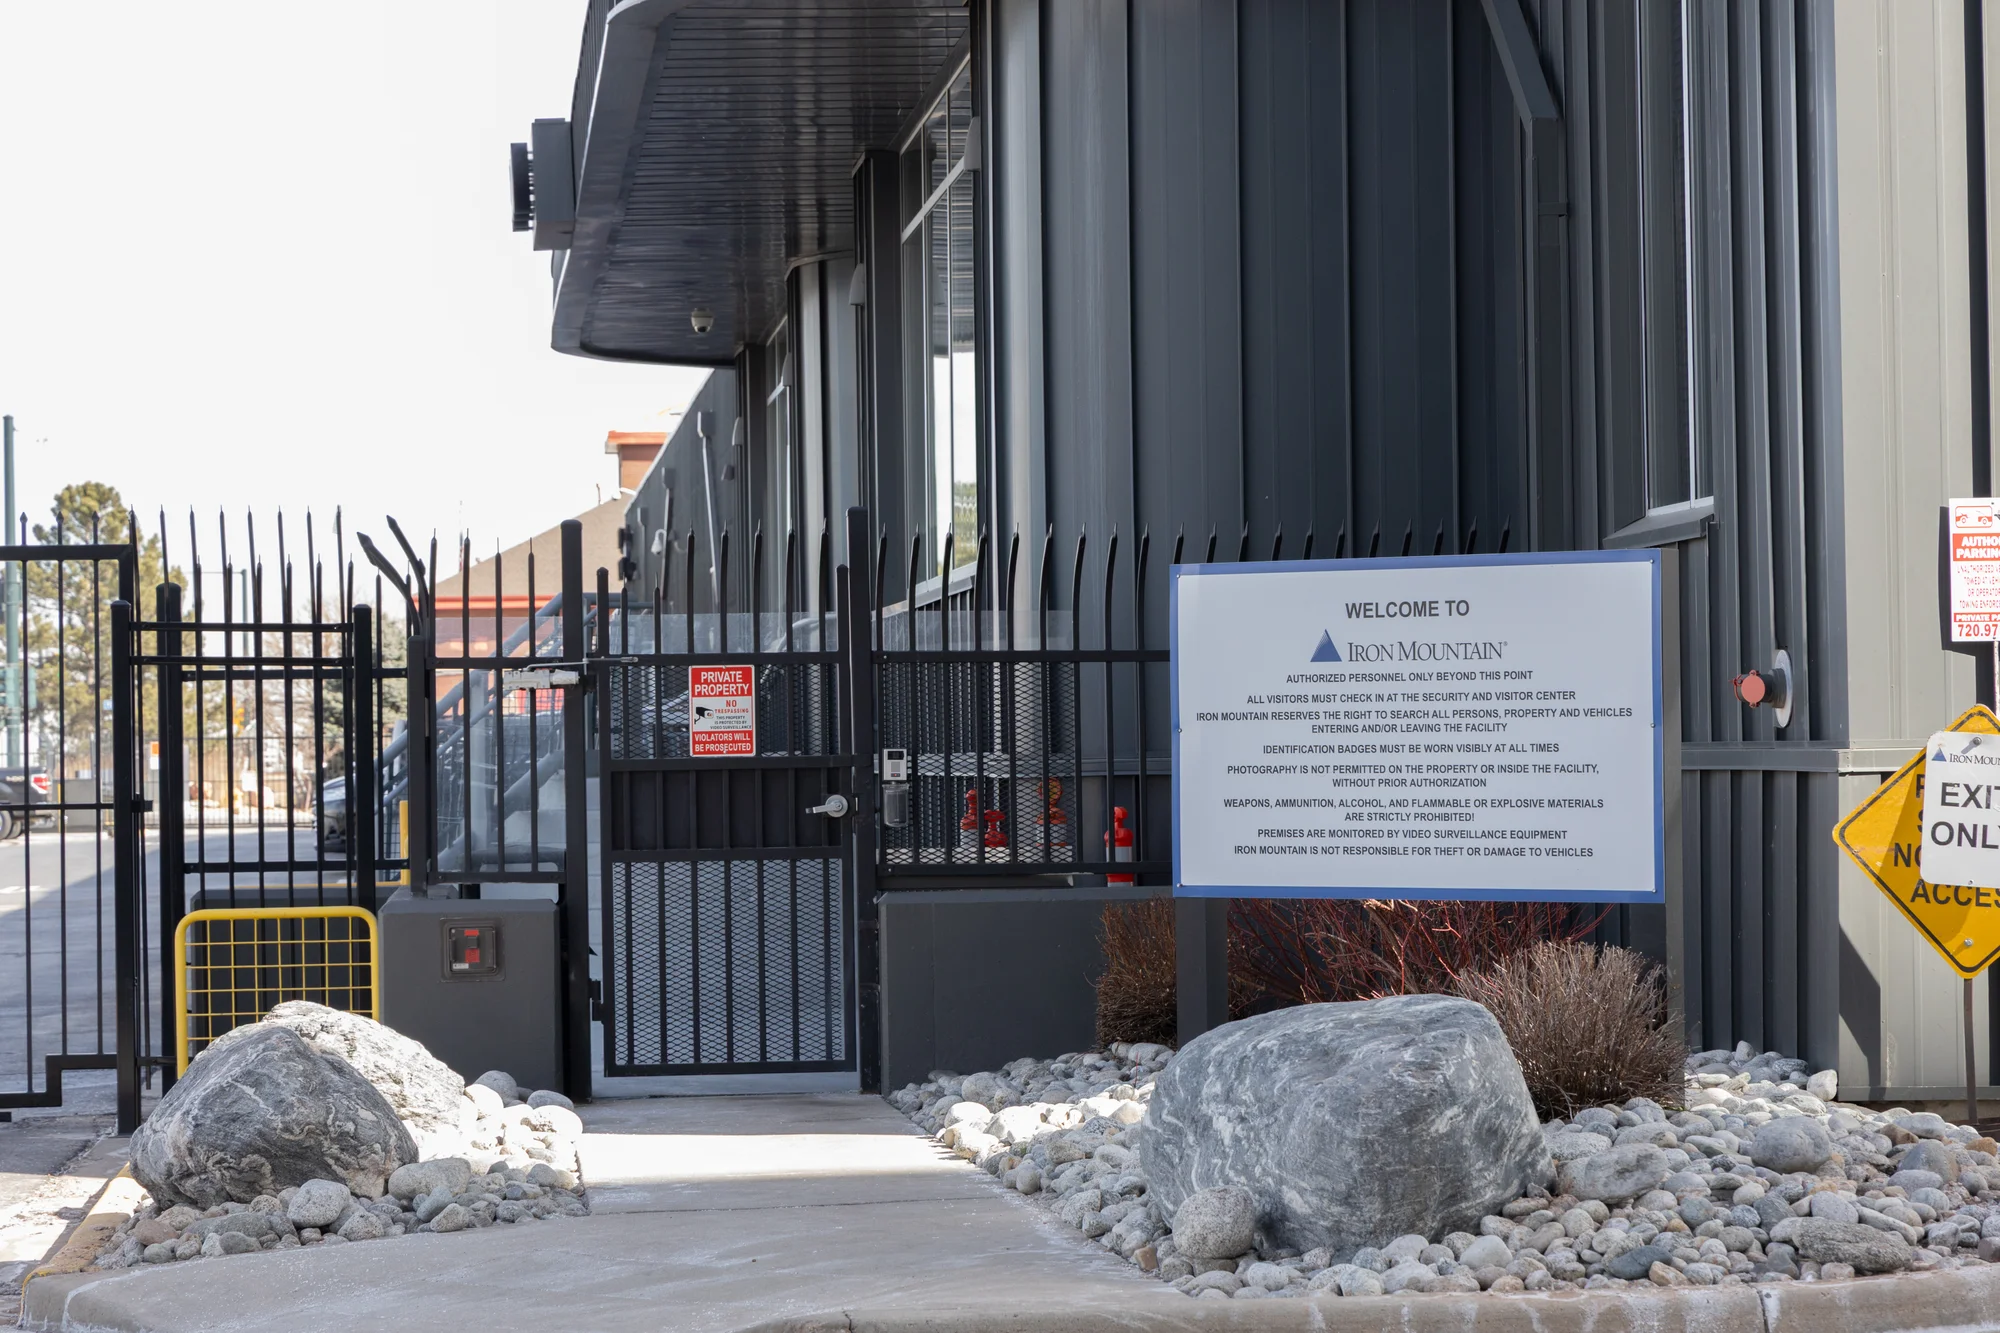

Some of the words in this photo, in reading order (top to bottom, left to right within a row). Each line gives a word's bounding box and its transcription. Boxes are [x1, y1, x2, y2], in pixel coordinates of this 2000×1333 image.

[1961, 535, 2000, 547] AUTHO
[1955, 548, 2000, 559] PARKIN
[1345, 601, 1439, 619] WELCOME
[1445, 599, 1469, 617] TO
[1956, 613, 1990, 622] PRIVATE
[1957, 623, 1998, 637] 720.97
[1348, 642, 1394, 662] IRON
[701, 671, 743, 683] PRIVATE
[1286, 673, 1346, 684] AUTHORIZED
[1349, 672, 1406, 683] PERSONNEL
[1409, 671, 1433, 682] ONLY
[1437, 671, 1476, 682] BEYOND
[1479, 670, 1501, 681] THIS
[1504, 670, 1533, 681] POINT
[694, 683, 749, 696] PROPERTY
[726, 699, 737, 708] NO
[1247, 694, 1265, 705] ALL
[1267, 693, 1309, 704] VISITORS
[1312, 693, 1337, 704] MUST
[1340, 693, 1372, 703] CHECK
[1375, 693, 1384, 703] IN
[1387, 692, 1398, 703] AT
[1401, 692, 1419, 703] THE
[1422, 691, 1469, 702] SECURITY
[1472, 691, 1492, 702] AND
[1495, 691, 1533, 701] VISITOR
[1536, 690, 1576, 701] CENTER
[1197, 712, 1218, 722] IRON
[1221, 711, 1268, 722] MOUNTAIN
[1271, 710, 1320, 721] RESERVES
[1323, 710, 1341, 720] THE
[1344, 710, 1372, 720] RIGHT
[1375, 709, 1387, 720] TO
[1390, 709, 1429, 720] SEARCH
[1432, 709, 1450, 719] ALL
[1453, 708, 1501, 720] PERSONS,
[1504, 708, 1557, 719] PROPERTY
[1559, 707, 1580, 718] AND
[1583, 707, 1632, 718] VEHICLES
[1312, 723, 1359, 734] ENTERING
[1361, 723, 1397, 734] AND/OR
[1401, 723, 1441, 733] LEAVING
[1444, 722, 1462, 733] THE
[1466, 722, 1507, 733] FACILITY
[694, 732, 733, 742] VIOLATORS
[734, 732, 751, 741] WILL
[695, 743, 704, 752] BE
[705, 742, 751, 752] PROSECUTED
[1263, 744, 1335, 755] IDENTIFICATION
[1338, 744, 1377, 754] BADGES
[1380, 743, 1406, 754] MUST
[1409, 743, 1421, 754] BE
[1424, 743, 1453, 754] WORN
[1456, 743, 1492, 753] VISIBLY
[1494, 743, 1506, 753] AT
[1509, 743, 1527, 753] ALL
[1530, 742, 1559, 753] TIMES
[1949, 753, 1973, 764] IRON
[1228, 764, 1297, 775] PHOTOGRAPHY
[1300, 764, 1308, 775] IS
[1311, 764, 1330, 775] NOT
[1333, 764, 1386, 774] PERMITTED
[1389, 764, 1402, 774] ON
[1405, 764, 1423, 774] THE
[1427, 764, 1478, 774] PROPERTY
[1481, 764, 1495, 774] OR
[1498, 763, 1529, 774] INSIDE
[1532, 763, 1551, 774] THE
[1554, 763, 1599, 775] FACILITY,
[1332, 777, 1375, 788] WITHOUT
[1378, 777, 1407, 788] PRIOR
[1410, 777, 1486, 788] AUTHORIZATION
[1224, 798, 1272, 809] WEAPONS,
[1275, 798, 1336, 810] AMMUNITION,
[1338, 798, 1386, 809] ALCOHOL,
[1389, 798, 1409, 808] AND
[1412, 798, 1471, 808] FLAMMABLE
[1474, 798, 1488, 809] OR
[1491, 798, 1544, 809] EXPLOSIVE
[1548, 798, 1603, 809] MATERIALS
[1345, 811, 1364, 822] ARE
[1367, 811, 1411, 822] STRICTLY
[1414, 812, 1474, 822] PROHIBITED!
[1258, 828, 1304, 839] PREMISES
[1307, 828, 1326, 839] ARE
[1329, 828, 1384, 839] MONITORED
[1387, 829, 1400, 839] BY
[1402, 829, 1431, 839] VIDEO
[1434, 829, 1507, 840] SURVEILLANCE
[1510, 829, 1567, 840] EQUIPMENT
[1931, 821, 2000, 849] ONL
[1235, 845, 1256, 855] IRON
[1260, 845, 1307, 855] MOUNTAIN
[1310, 845, 1318, 855] IS
[1321, 845, 1340, 856] NOT
[1343, 845, 1409, 856] RESPONSIBLE
[1412, 846, 1431, 856] FOR
[1434, 846, 1464, 856] THEFT
[1467, 846, 1481, 857] OR
[1484, 846, 1526, 857] DAMAGE
[1529, 847, 1542, 857] TO
[1544, 847, 1593, 858] VEHICLES
